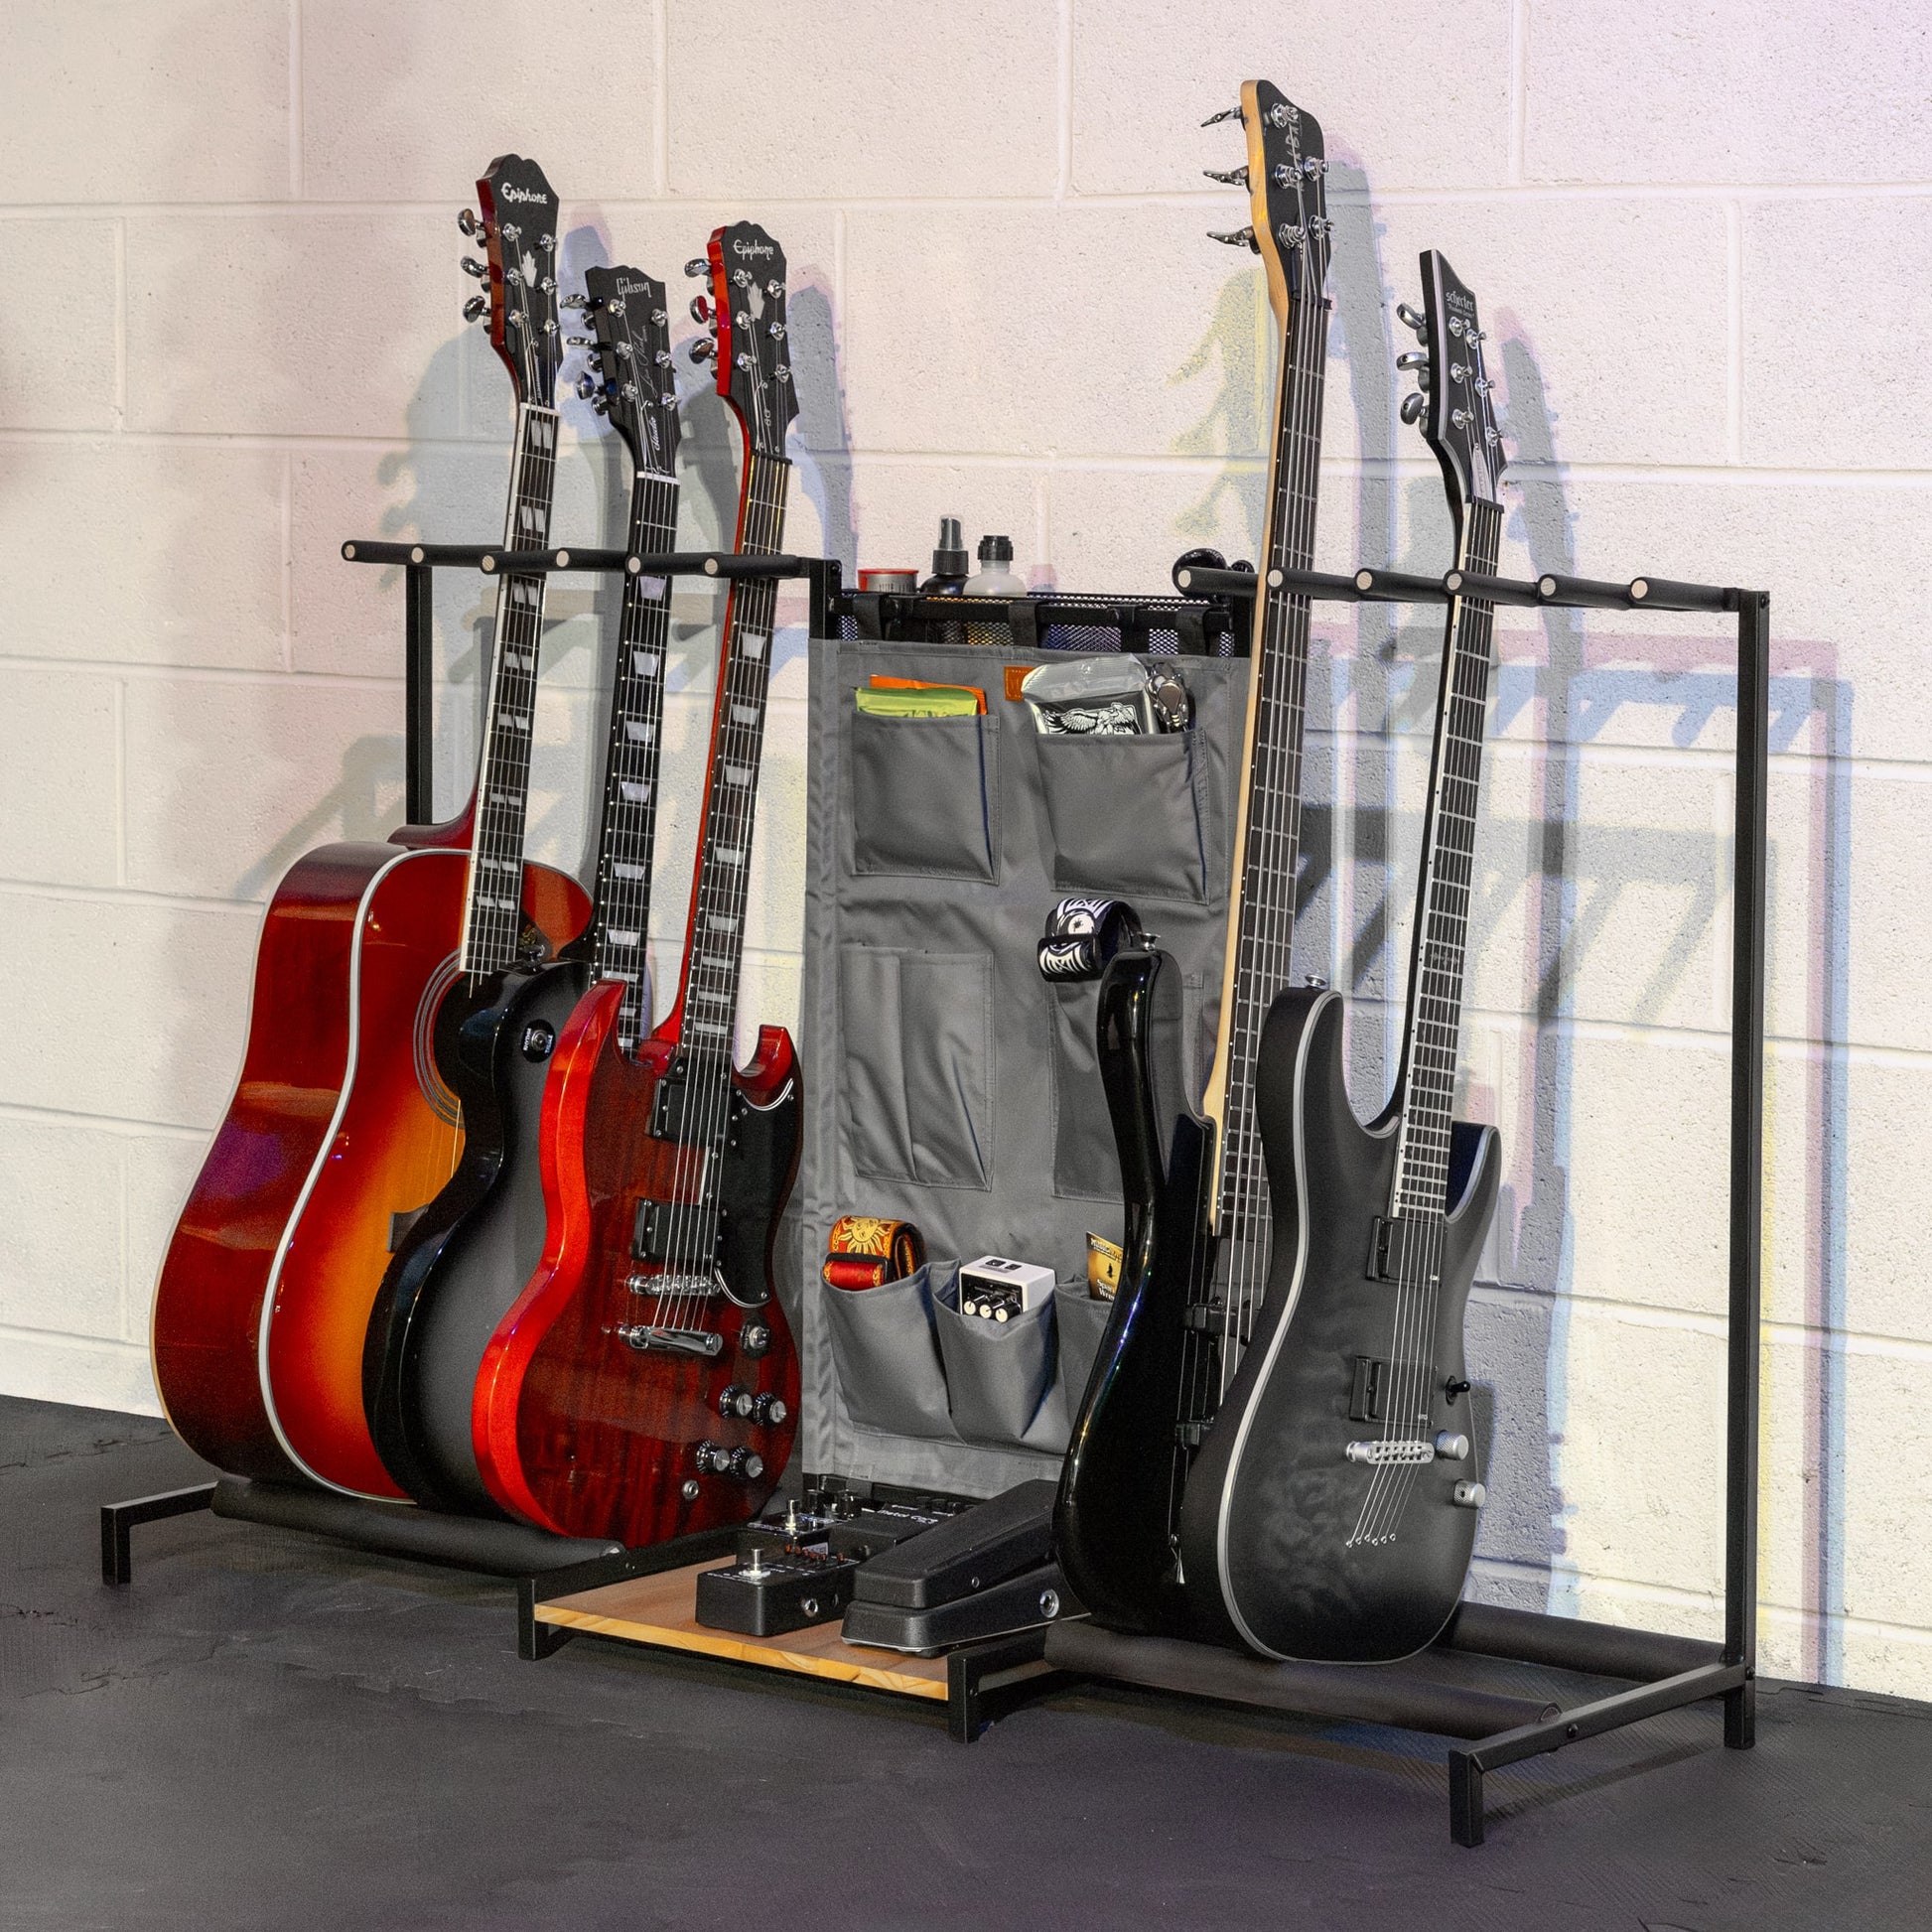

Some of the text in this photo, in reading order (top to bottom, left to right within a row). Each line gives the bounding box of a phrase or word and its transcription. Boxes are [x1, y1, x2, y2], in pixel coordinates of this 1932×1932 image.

[500, 182, 548, 205] Epiphone
[733, 238, 774, 261] Epiphone
[616, 276, 652, 302] Gibson
